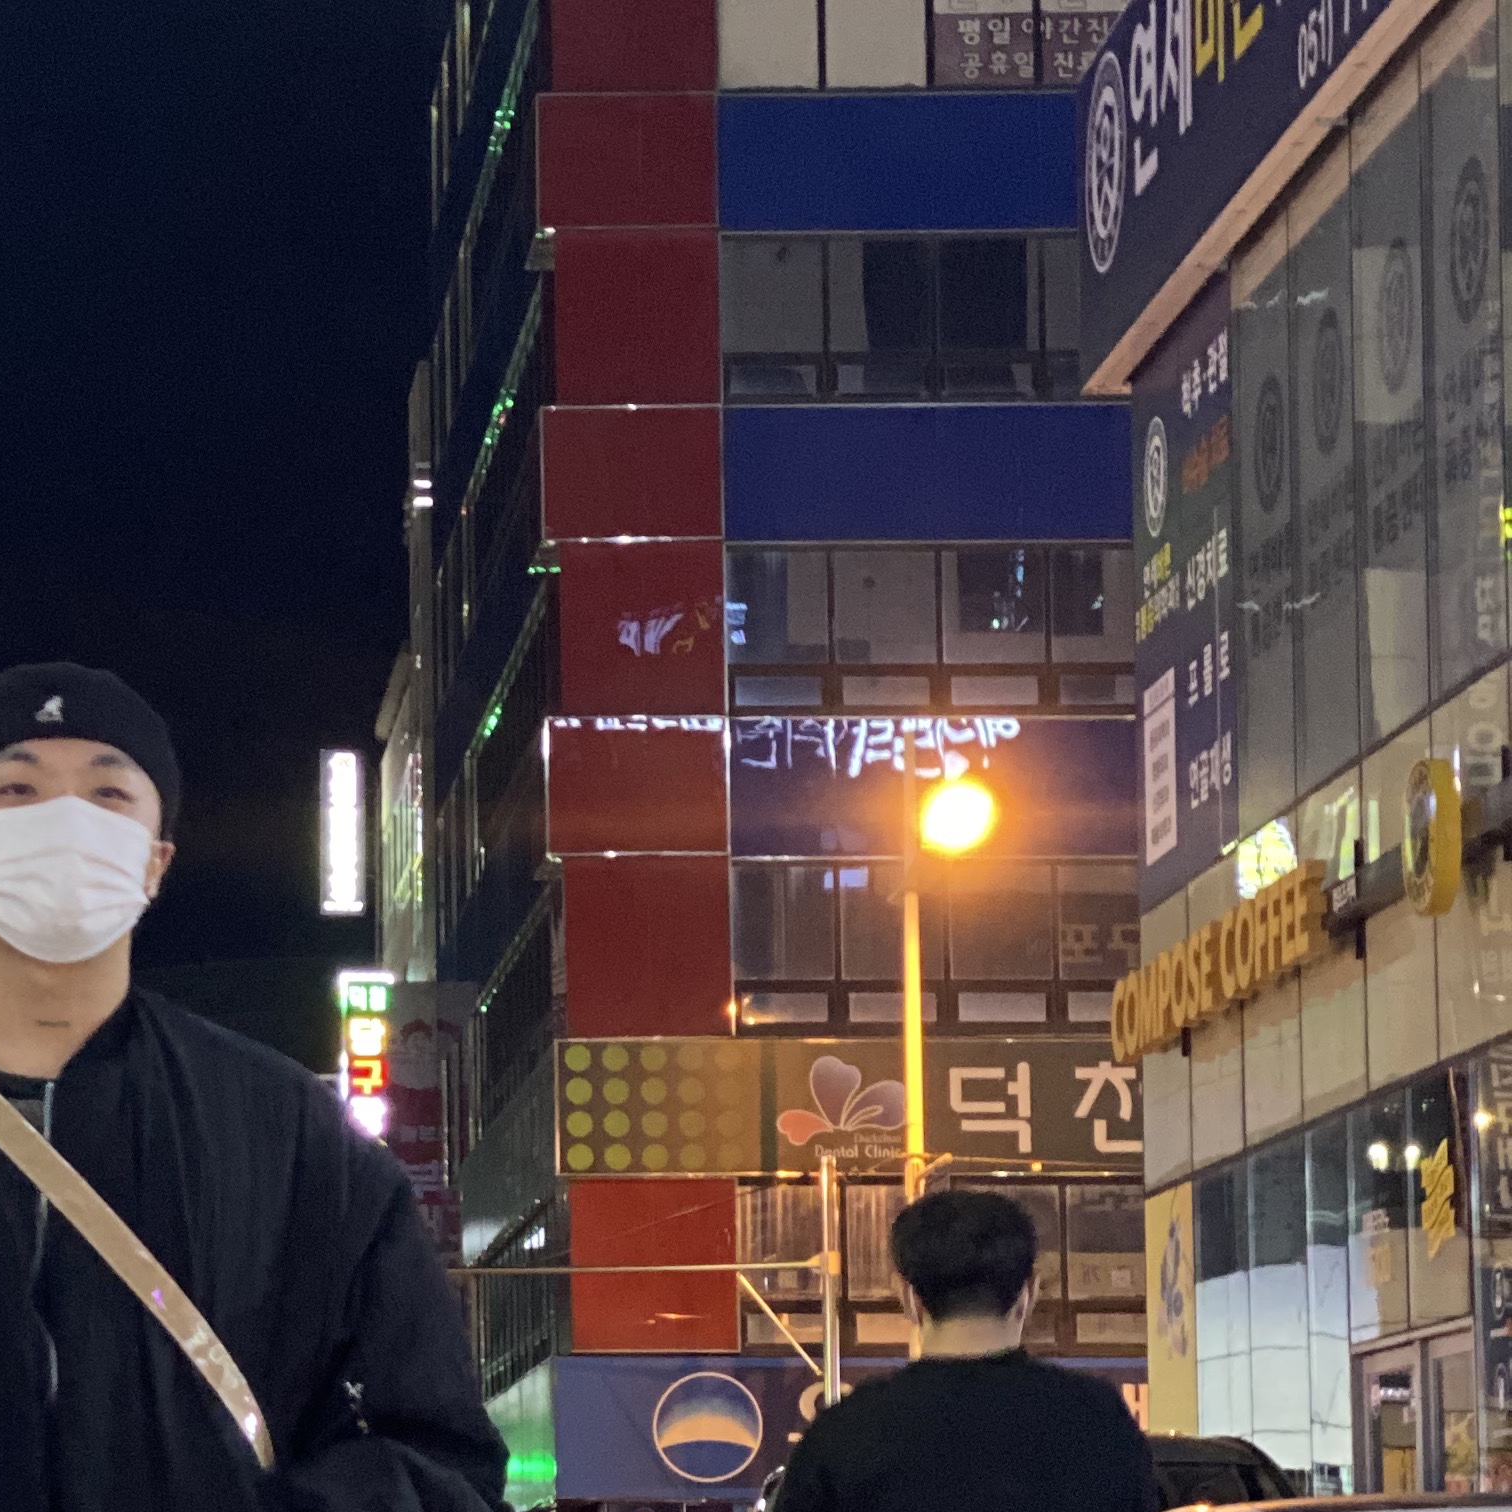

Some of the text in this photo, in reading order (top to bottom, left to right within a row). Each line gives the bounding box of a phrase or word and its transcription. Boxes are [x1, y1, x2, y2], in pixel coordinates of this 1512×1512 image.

[957, 17, 1013, 46] 평일
[958, 51, 1035, 80] 공휴일
[1111, 861, 1311, 1063] COMPOSE COFFEE
